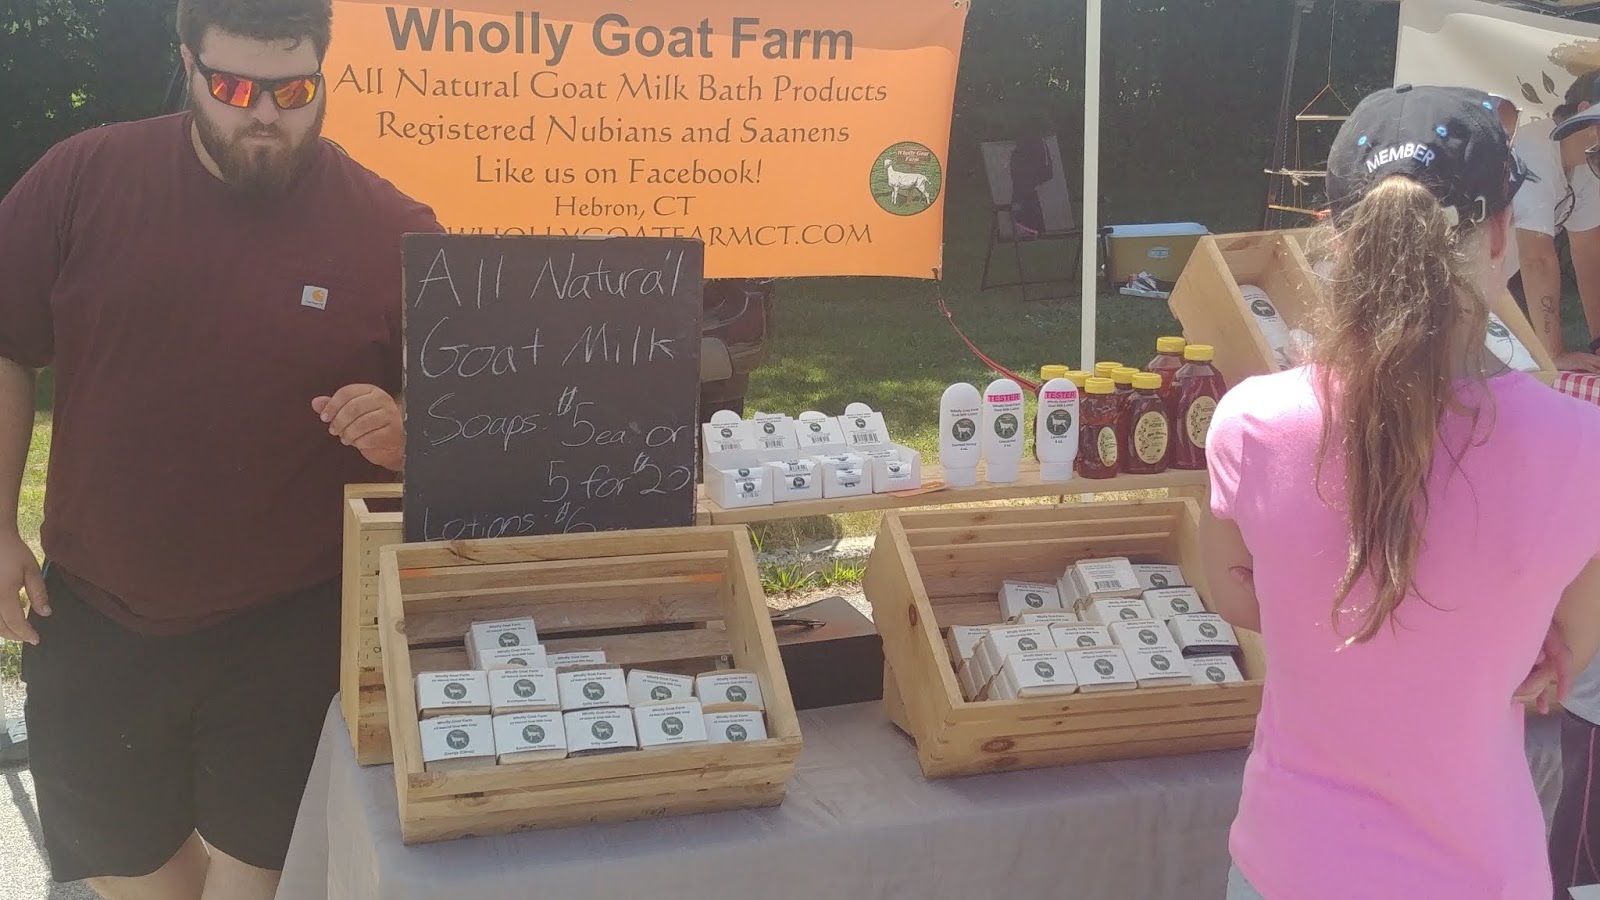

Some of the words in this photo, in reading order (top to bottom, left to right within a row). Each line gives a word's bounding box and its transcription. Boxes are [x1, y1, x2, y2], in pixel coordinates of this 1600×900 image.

[385, 6, 573, 66] Wholly
[592, 13, 714, 58] Goat
[731, 17, 853, 60] Farm
[332, 64, 383, 95] All
[395, 67, 520, 99] Natural
[529, 70, 608, 100] Goat
[616, 72, 689, 102] Milk
[697, 73, 762, 102] Bath
[772, 75, 888, 103] Products
[376, 110, 536, 145] Registered
[545, 114, 673, 145] Nubians
[681, 117, 732, 144] and
[739, 117, 850, 144] Saanens
[475, 154, 535, 184] Like
[545, 166, 576, 184] us
[584, 167, 618, 184] on
[628, 157, 763, 185] Facebook!
[1366, 143, 1435, 173] MEMBER
[554, 195, 646, 221] Hebron,
[653, 195, 697, 217] CT
[415, 248, 503, 309] All
[530, 249, 685, 300] Natural
[420, 316, 545, 378] Goat
[562, 321, 676, 367] Milk
[987, 393, 1021, 402] TESTER
[1045, 390, 1076, 399] TESTER
[645, 425, 688, 447] or
[542, 460, 569, 503] 5
[580, 464, 631, 500] for
